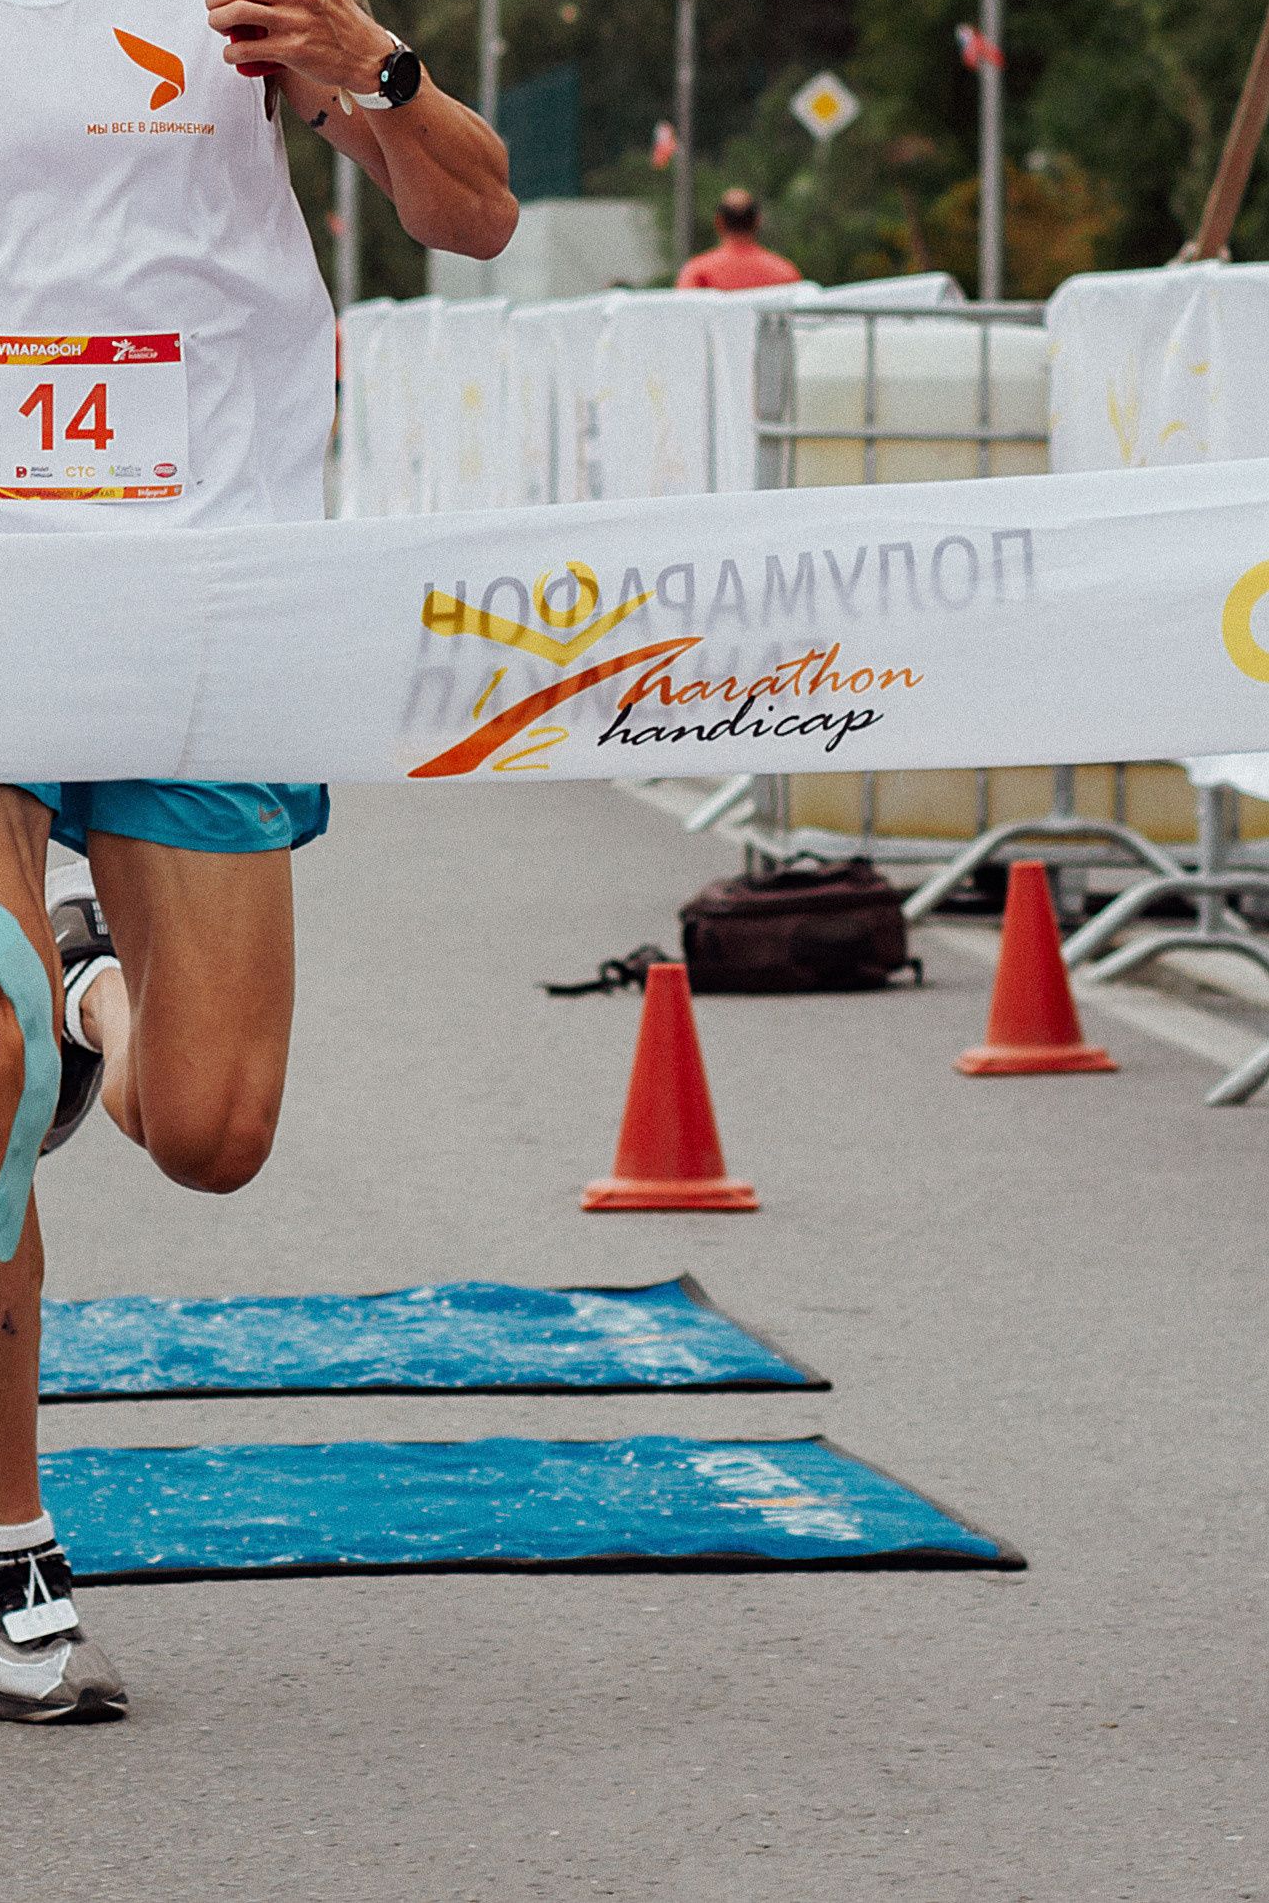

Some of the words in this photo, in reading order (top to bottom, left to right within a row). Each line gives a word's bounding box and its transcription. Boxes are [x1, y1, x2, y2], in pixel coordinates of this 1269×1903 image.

[87, 123, 108, 136] МЫ
[111, 122, 133, 134] ВСЕ
[138, 122, 146, 133] В
[149, 122, 215, 136] ДВИЖЕНИИ
[18, 383, 114, 451] 14
[597, 695, 885, 753] handicap
